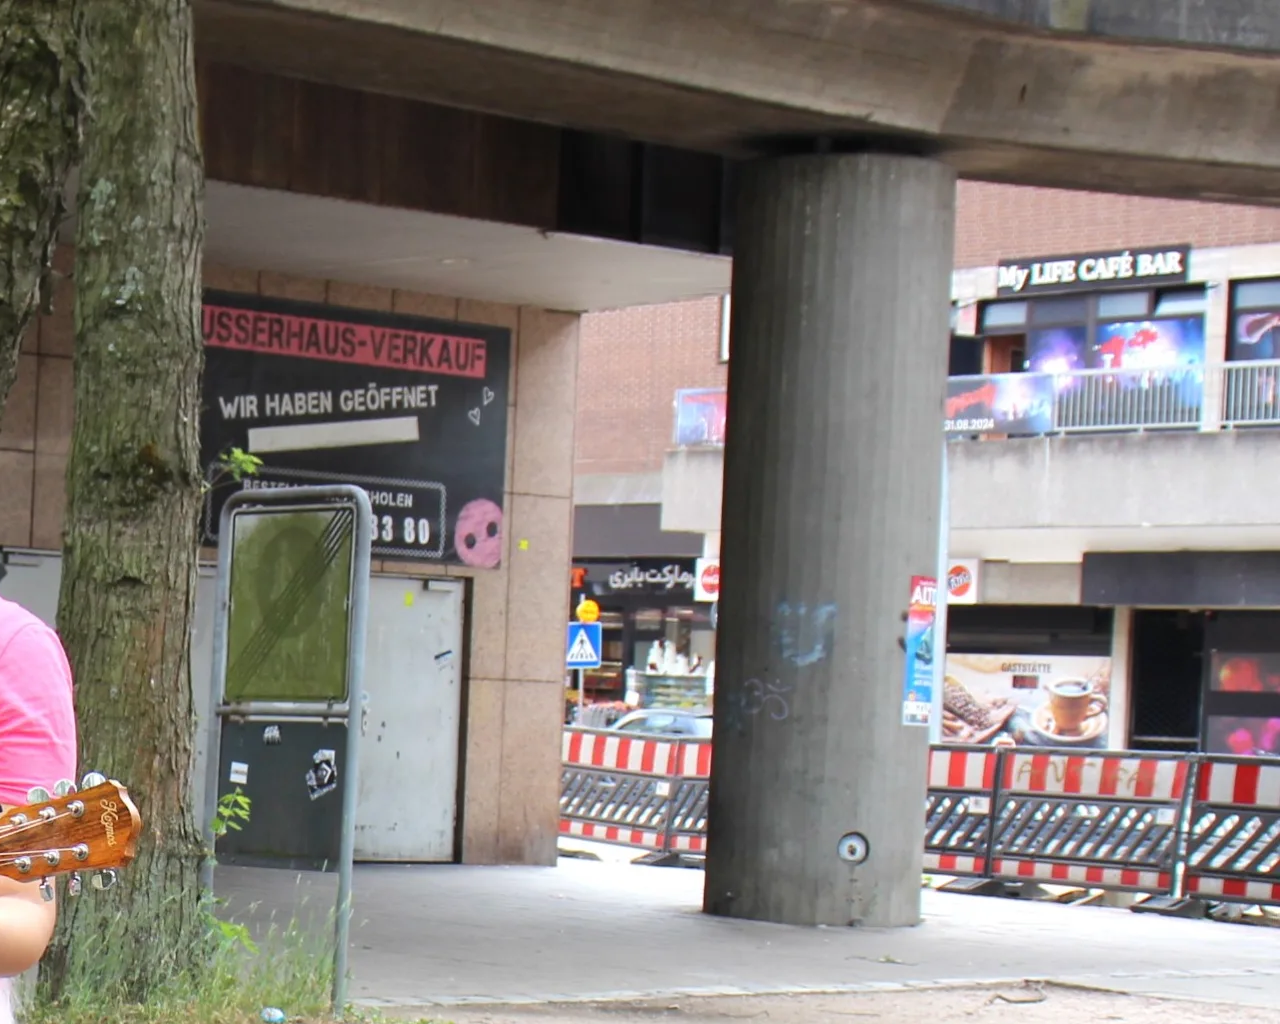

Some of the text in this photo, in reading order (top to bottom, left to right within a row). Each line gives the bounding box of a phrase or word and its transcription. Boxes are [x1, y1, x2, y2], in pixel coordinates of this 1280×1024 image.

[998, 251, 1183, 292] My LIFE CAFÉ BAR
[202, 306, 485, 371] USSERHAUS-VERKAUF
[219, 383, 439, 419] WIR HABEN GEÖFFNET
[403, 516, 430, 545] 80
